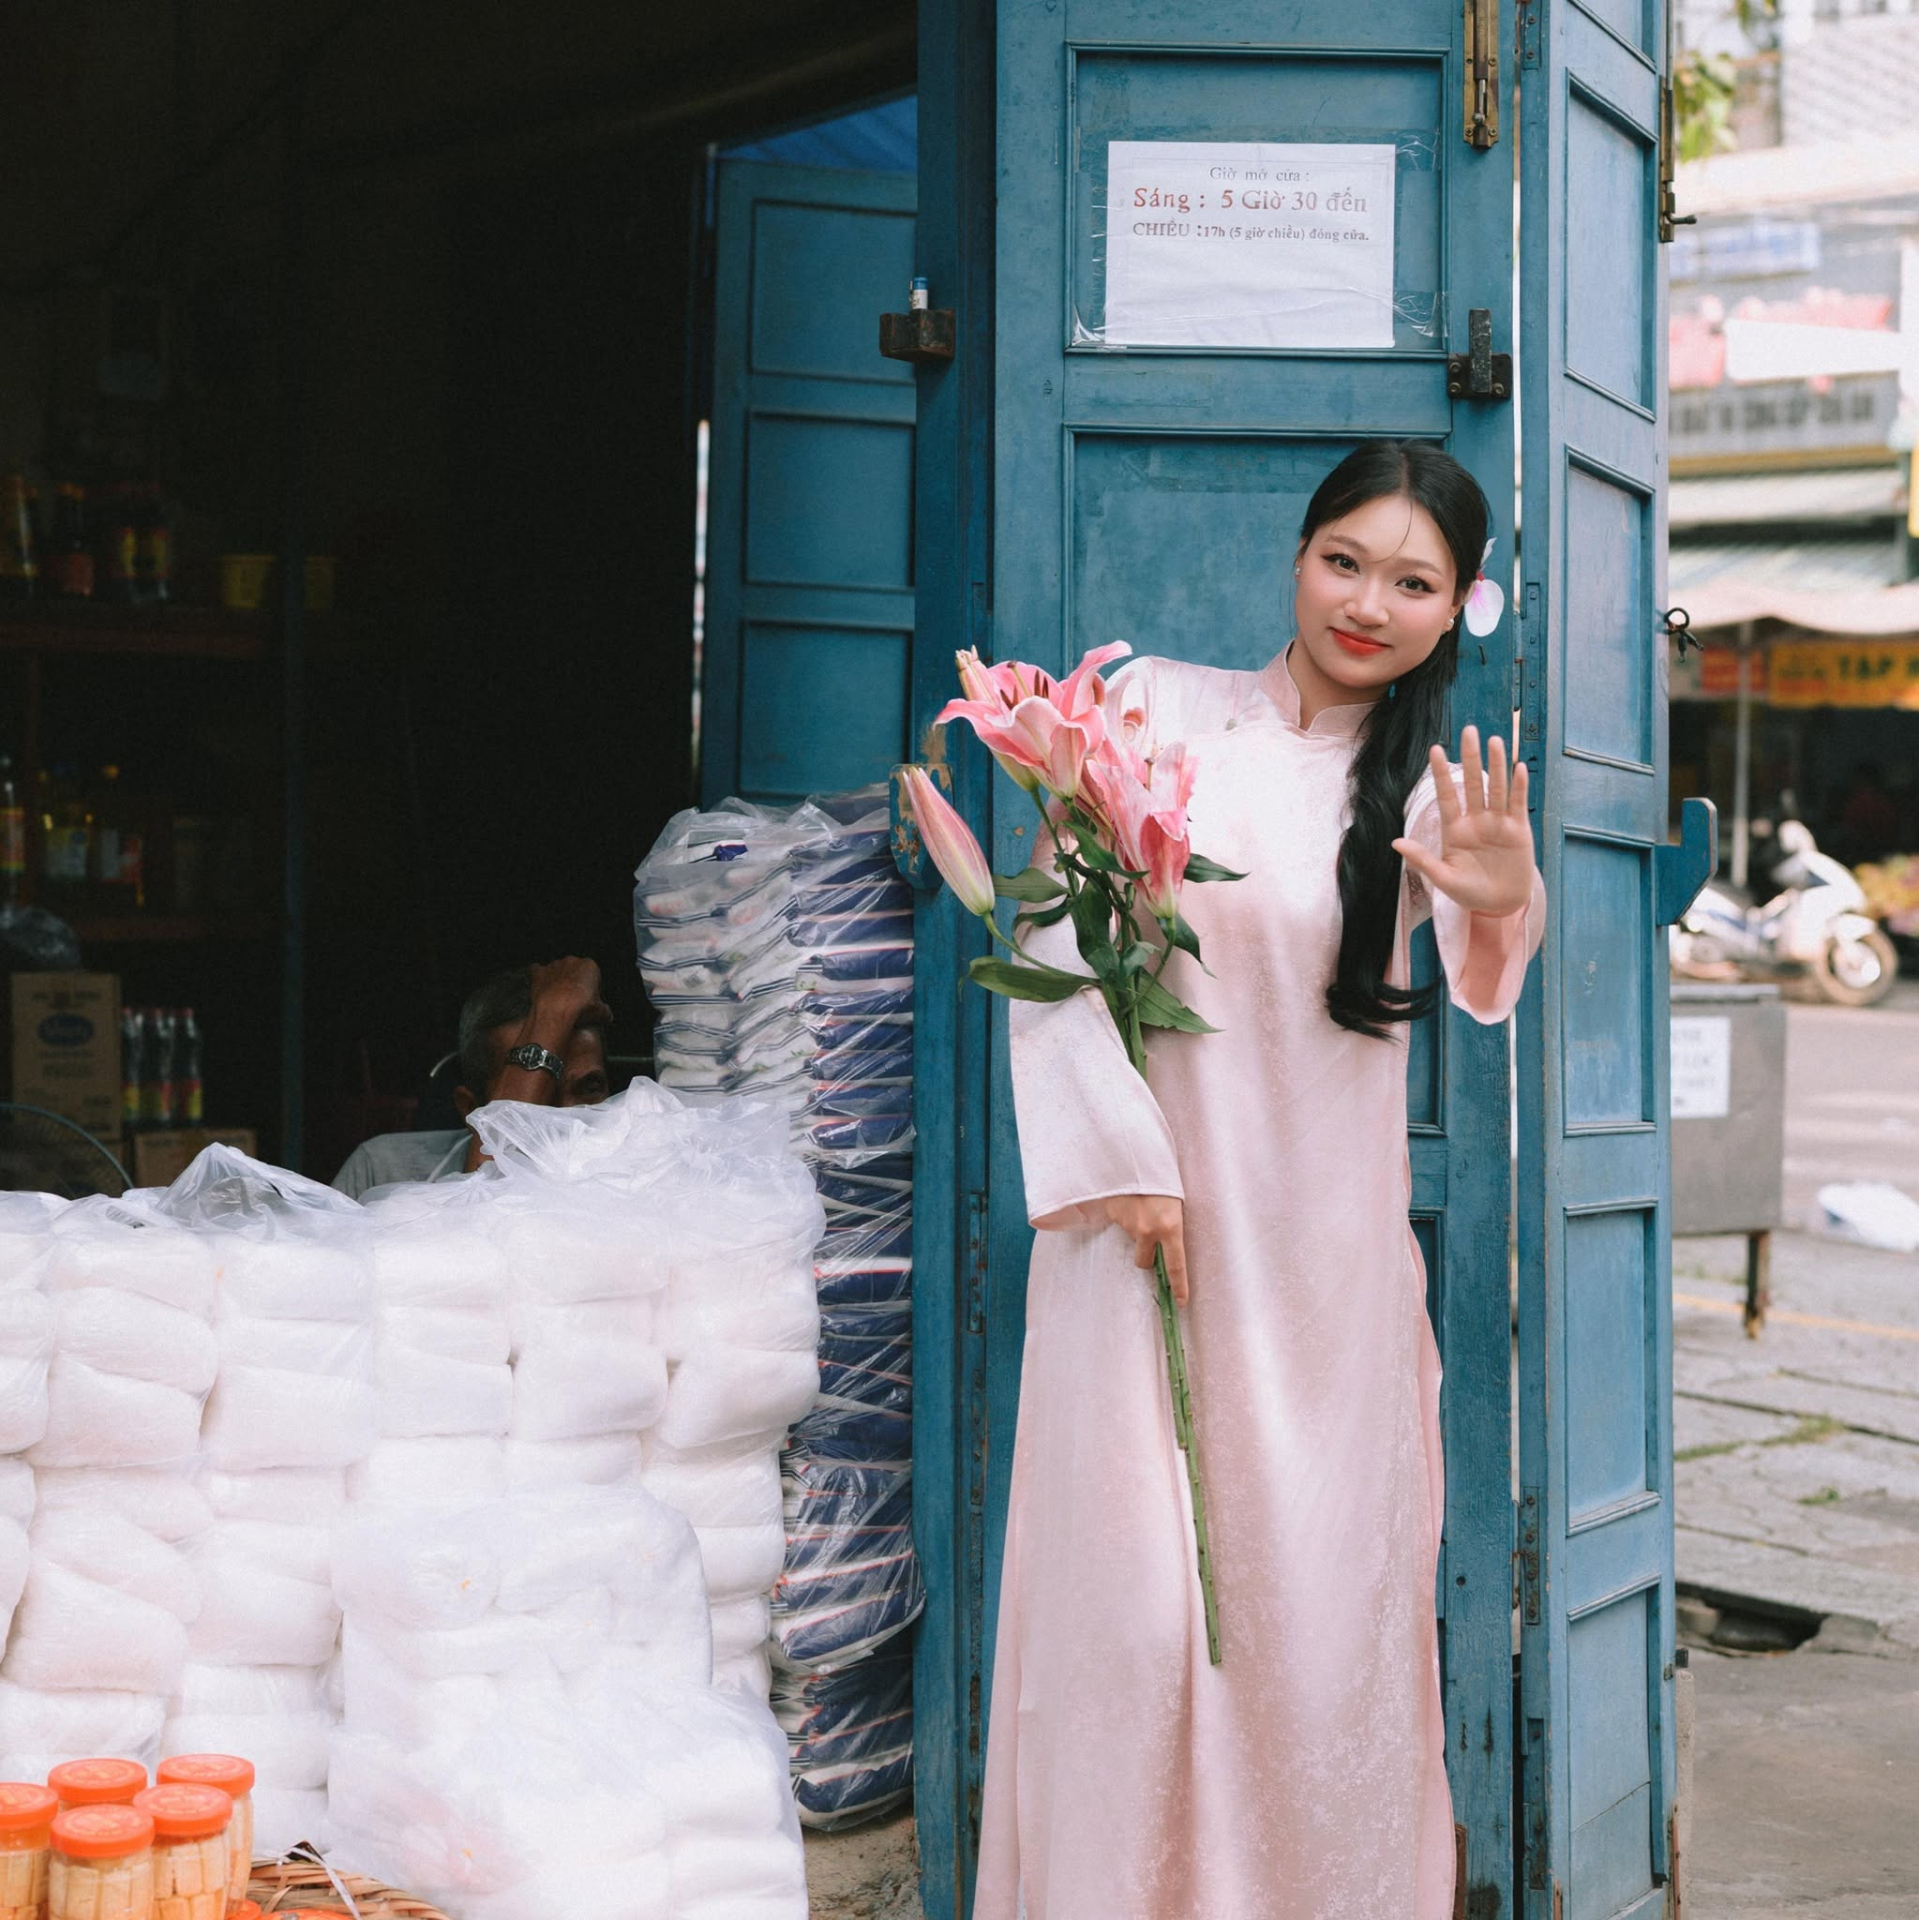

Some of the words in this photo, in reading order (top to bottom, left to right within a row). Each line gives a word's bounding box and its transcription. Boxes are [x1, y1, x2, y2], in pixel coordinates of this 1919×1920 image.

[1209, 166, 1238, 181] Giờ
[1133, 187, 1191, 214] Sáng
[1220, 189, 1234, 209] 5
[1241, 189, 1286, 211] Giờ
[1291, 191, 1318, 211] 30
[1325, 186, 1368, 213] đến
[1229, 226, 1243, 240] (5
[1244, 226, 1266, 241] giờ
[1267, 224, 1306, 241] chiều)
[1308, 227, 1340, 243] đóng
